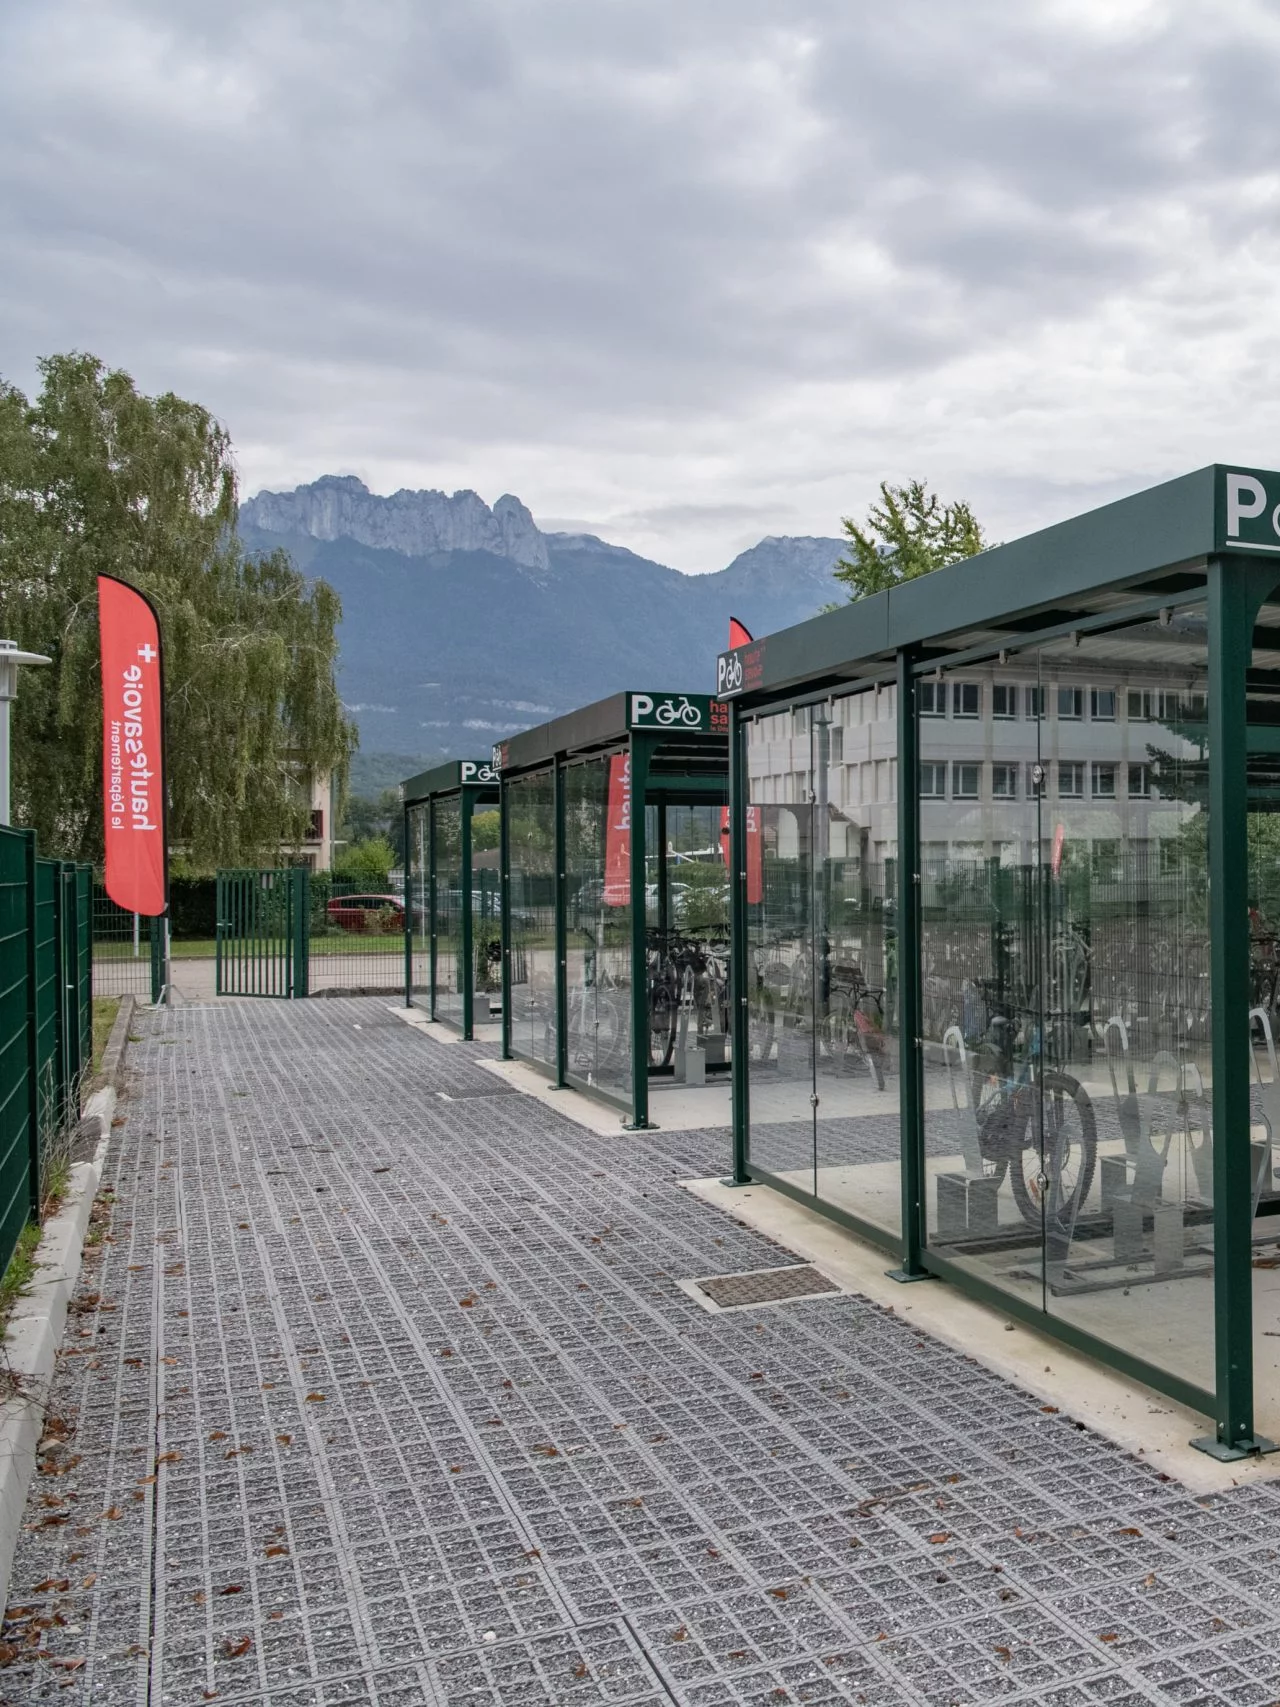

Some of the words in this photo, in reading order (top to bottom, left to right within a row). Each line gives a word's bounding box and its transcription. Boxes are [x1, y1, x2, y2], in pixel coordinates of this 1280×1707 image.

[1226, 473, 1268, 537] P
[718, 657, 726, 693] P
[631, 694, 654, 724] P
[462, 762, 477, 781] P
